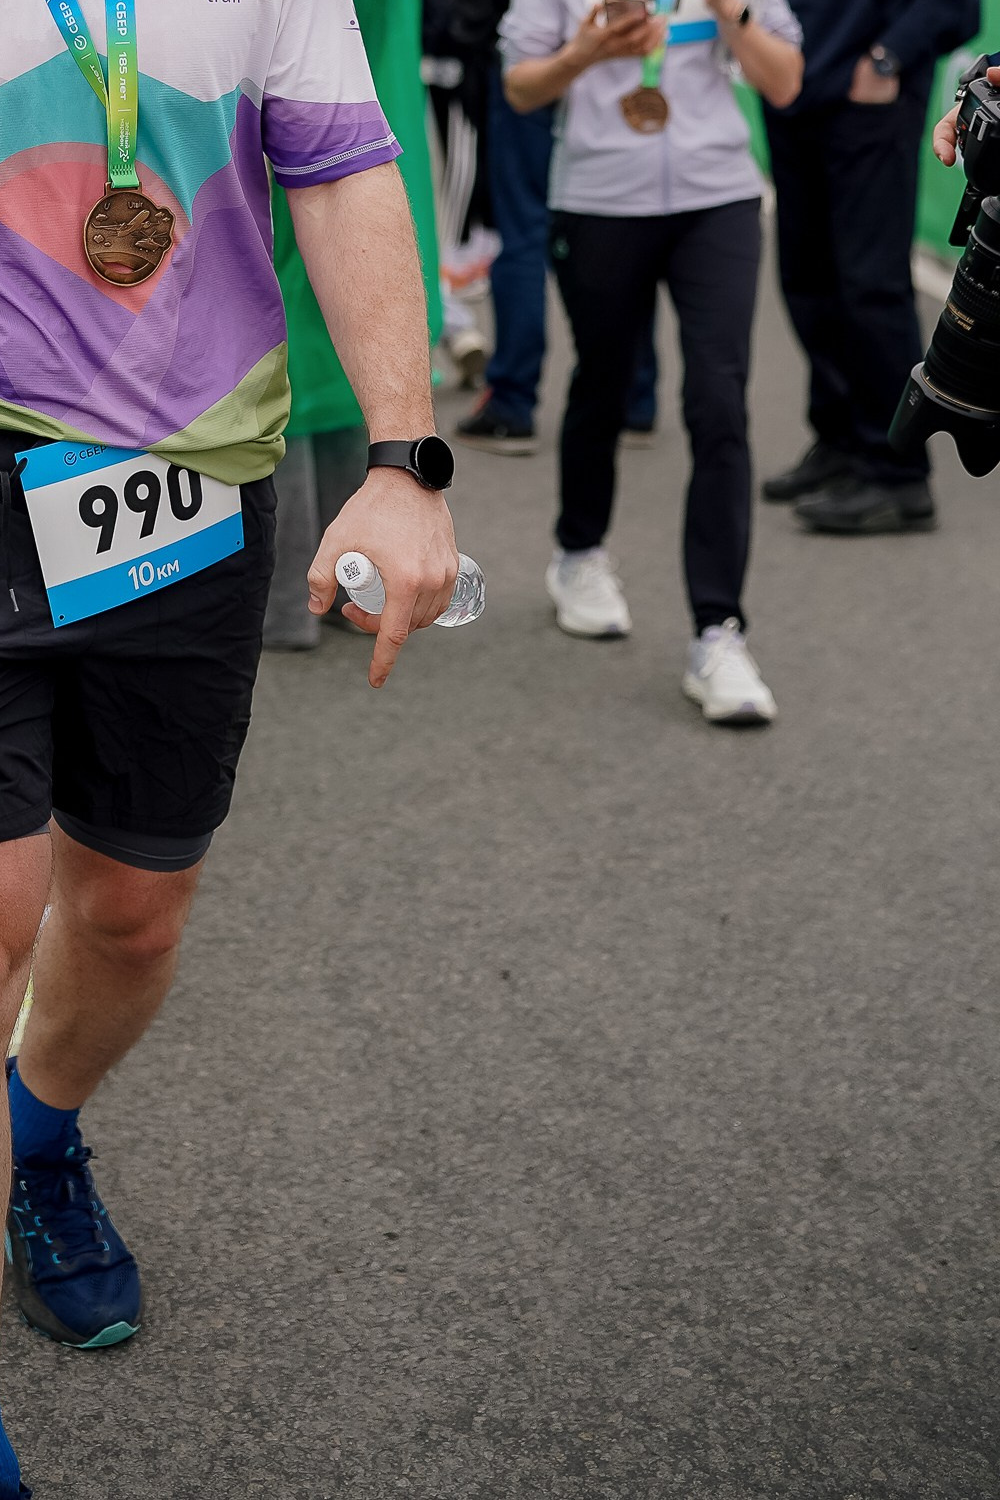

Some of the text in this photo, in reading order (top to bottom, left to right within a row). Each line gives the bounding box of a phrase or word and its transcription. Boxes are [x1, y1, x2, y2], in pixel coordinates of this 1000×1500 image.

[59, 2, 79, 34] СБЕР
[116, 3, 127, 36] СБЕР
[118, 52, 127, 74] 185
[78, 463, 204, 555] 990
